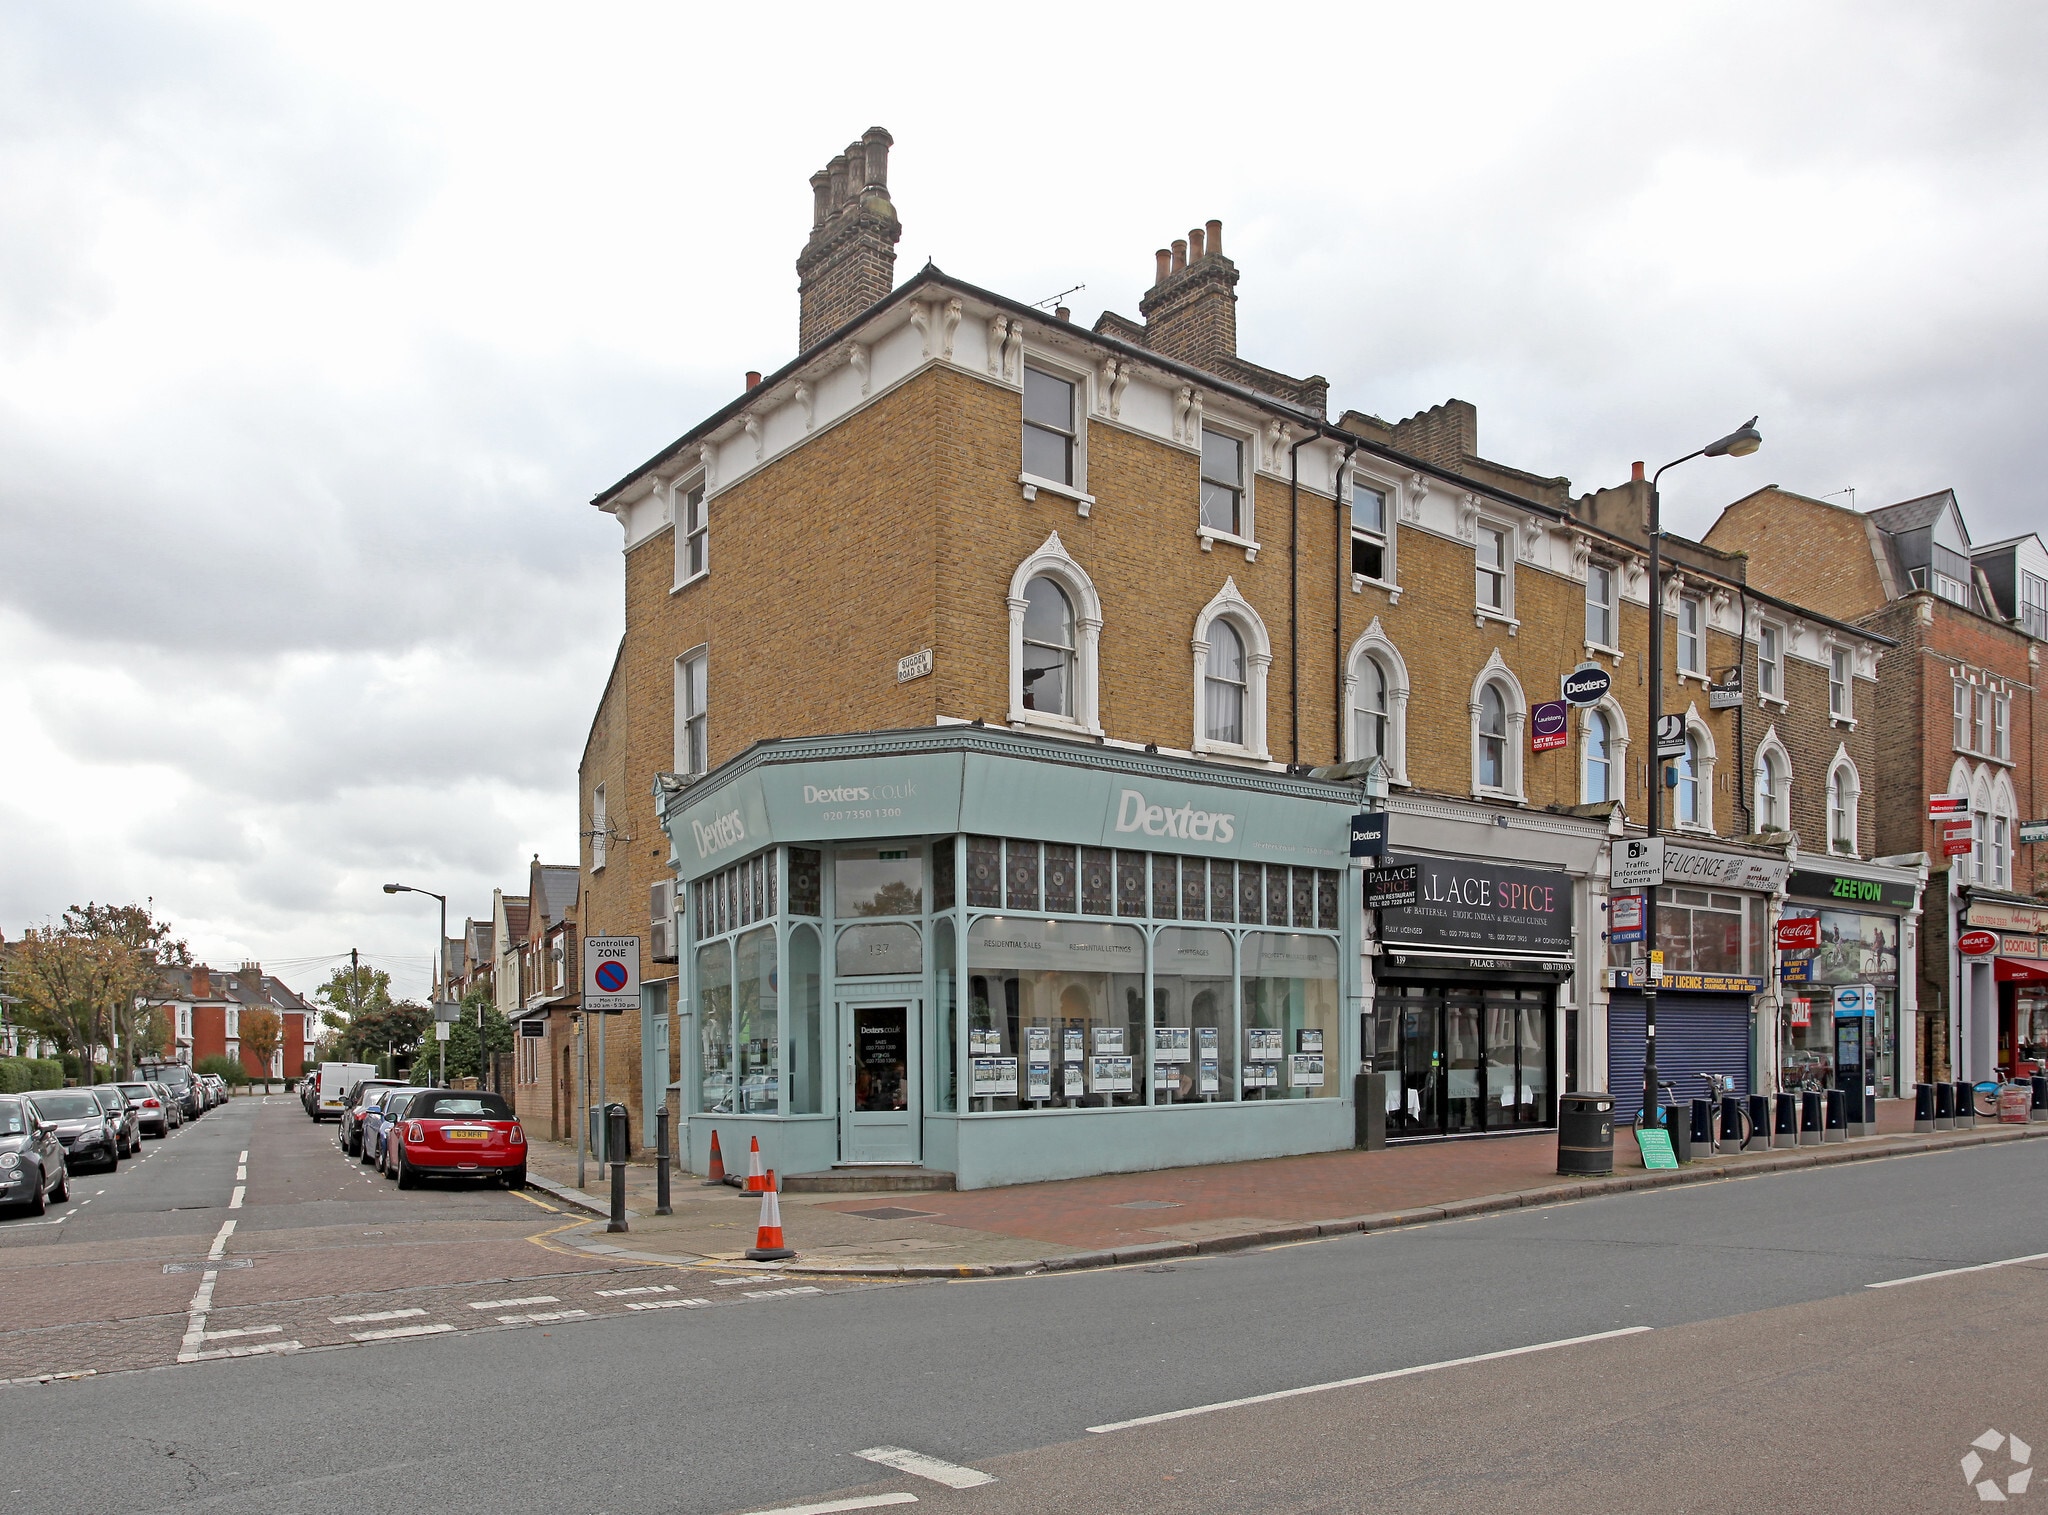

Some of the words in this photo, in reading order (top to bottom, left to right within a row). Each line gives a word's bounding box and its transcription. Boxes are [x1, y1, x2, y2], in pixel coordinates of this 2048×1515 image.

[902, 653, 926, 669] SUGDEN
[899, 668, 915, 680] ROAD
[1566, 679, 1608, 694] Dexters
[1728, 691, 1738, 699] BY
[1537, 715, 1561, 723] Lauristons
[823, 811, 843, 821] 020
[845, 810, 872, 819] 7350
[875, 807, 902, 818] 1300
[1114, 789, 1236, 844] Dexters
[691, 809, 745, 859] Dexters
[1352, 830, 1381, 842] Dexters
[1625, 861, 1650, 869] Traffic
[1674, 854, 1725, 877] LICENCE
[1369, 867, 1417, 883] PALACE
[1614, 868, 1661, 877] Enforcement
[1376, 880, 1410, 894] SPICE
[1833, 878, 1883, 902] ZEEVON
[1369, 894, 1385, 902] INDIAN
[1385, 891, 1416, 900] RESTAURANT
[1498, 881, 1555, 912] SPICE
[1403, 906, 1412, 914] OF
[1414, 907, 1448, 917] BATTERSEA
[1452, 911, 1473, 920] EXOTIC
[1474, 912, 1496, 921] INDIAN
[1503, 915, 1525, 924] BENGALI
[1526, 916, 1548, 926] CUISINE
[1976, 915, 1985, 924] 020
[1385, 925, 1399, 933] FULLY
[1400, 926, 1423, 935] LICENSED
[1542, 937, 1570, 946] CONDITIONED
[1621, 932, 1641, 940] LICENCE
[589, 940, 635, 948] Controlled
[868, 943, 890, 956] 137
[984, 940, 1023, 949] RESIDENTIAL
[1023, 941, 1042, 949] SALES
[1069, 943, 1105, 952] RESIDENTIAL
[1105, 945, 1132, 953] LETTINGS
[2004, 939, 2036, 953] COCKTAILS
[597, 949, 627, 958] ZONE
[1177, 948, 1209, 957] MORTGAGES
[1469, 959, 1495, 968] PALACE
[1496, 960, 1513, 969] SPICE
[1661, 975, 1674, 988] OFF
[1675, 975, 1703, 989] LICENCE
[1783, 973, 1807, 981] LICENCE
[1791, 1001, 1810, 1023] SALE
